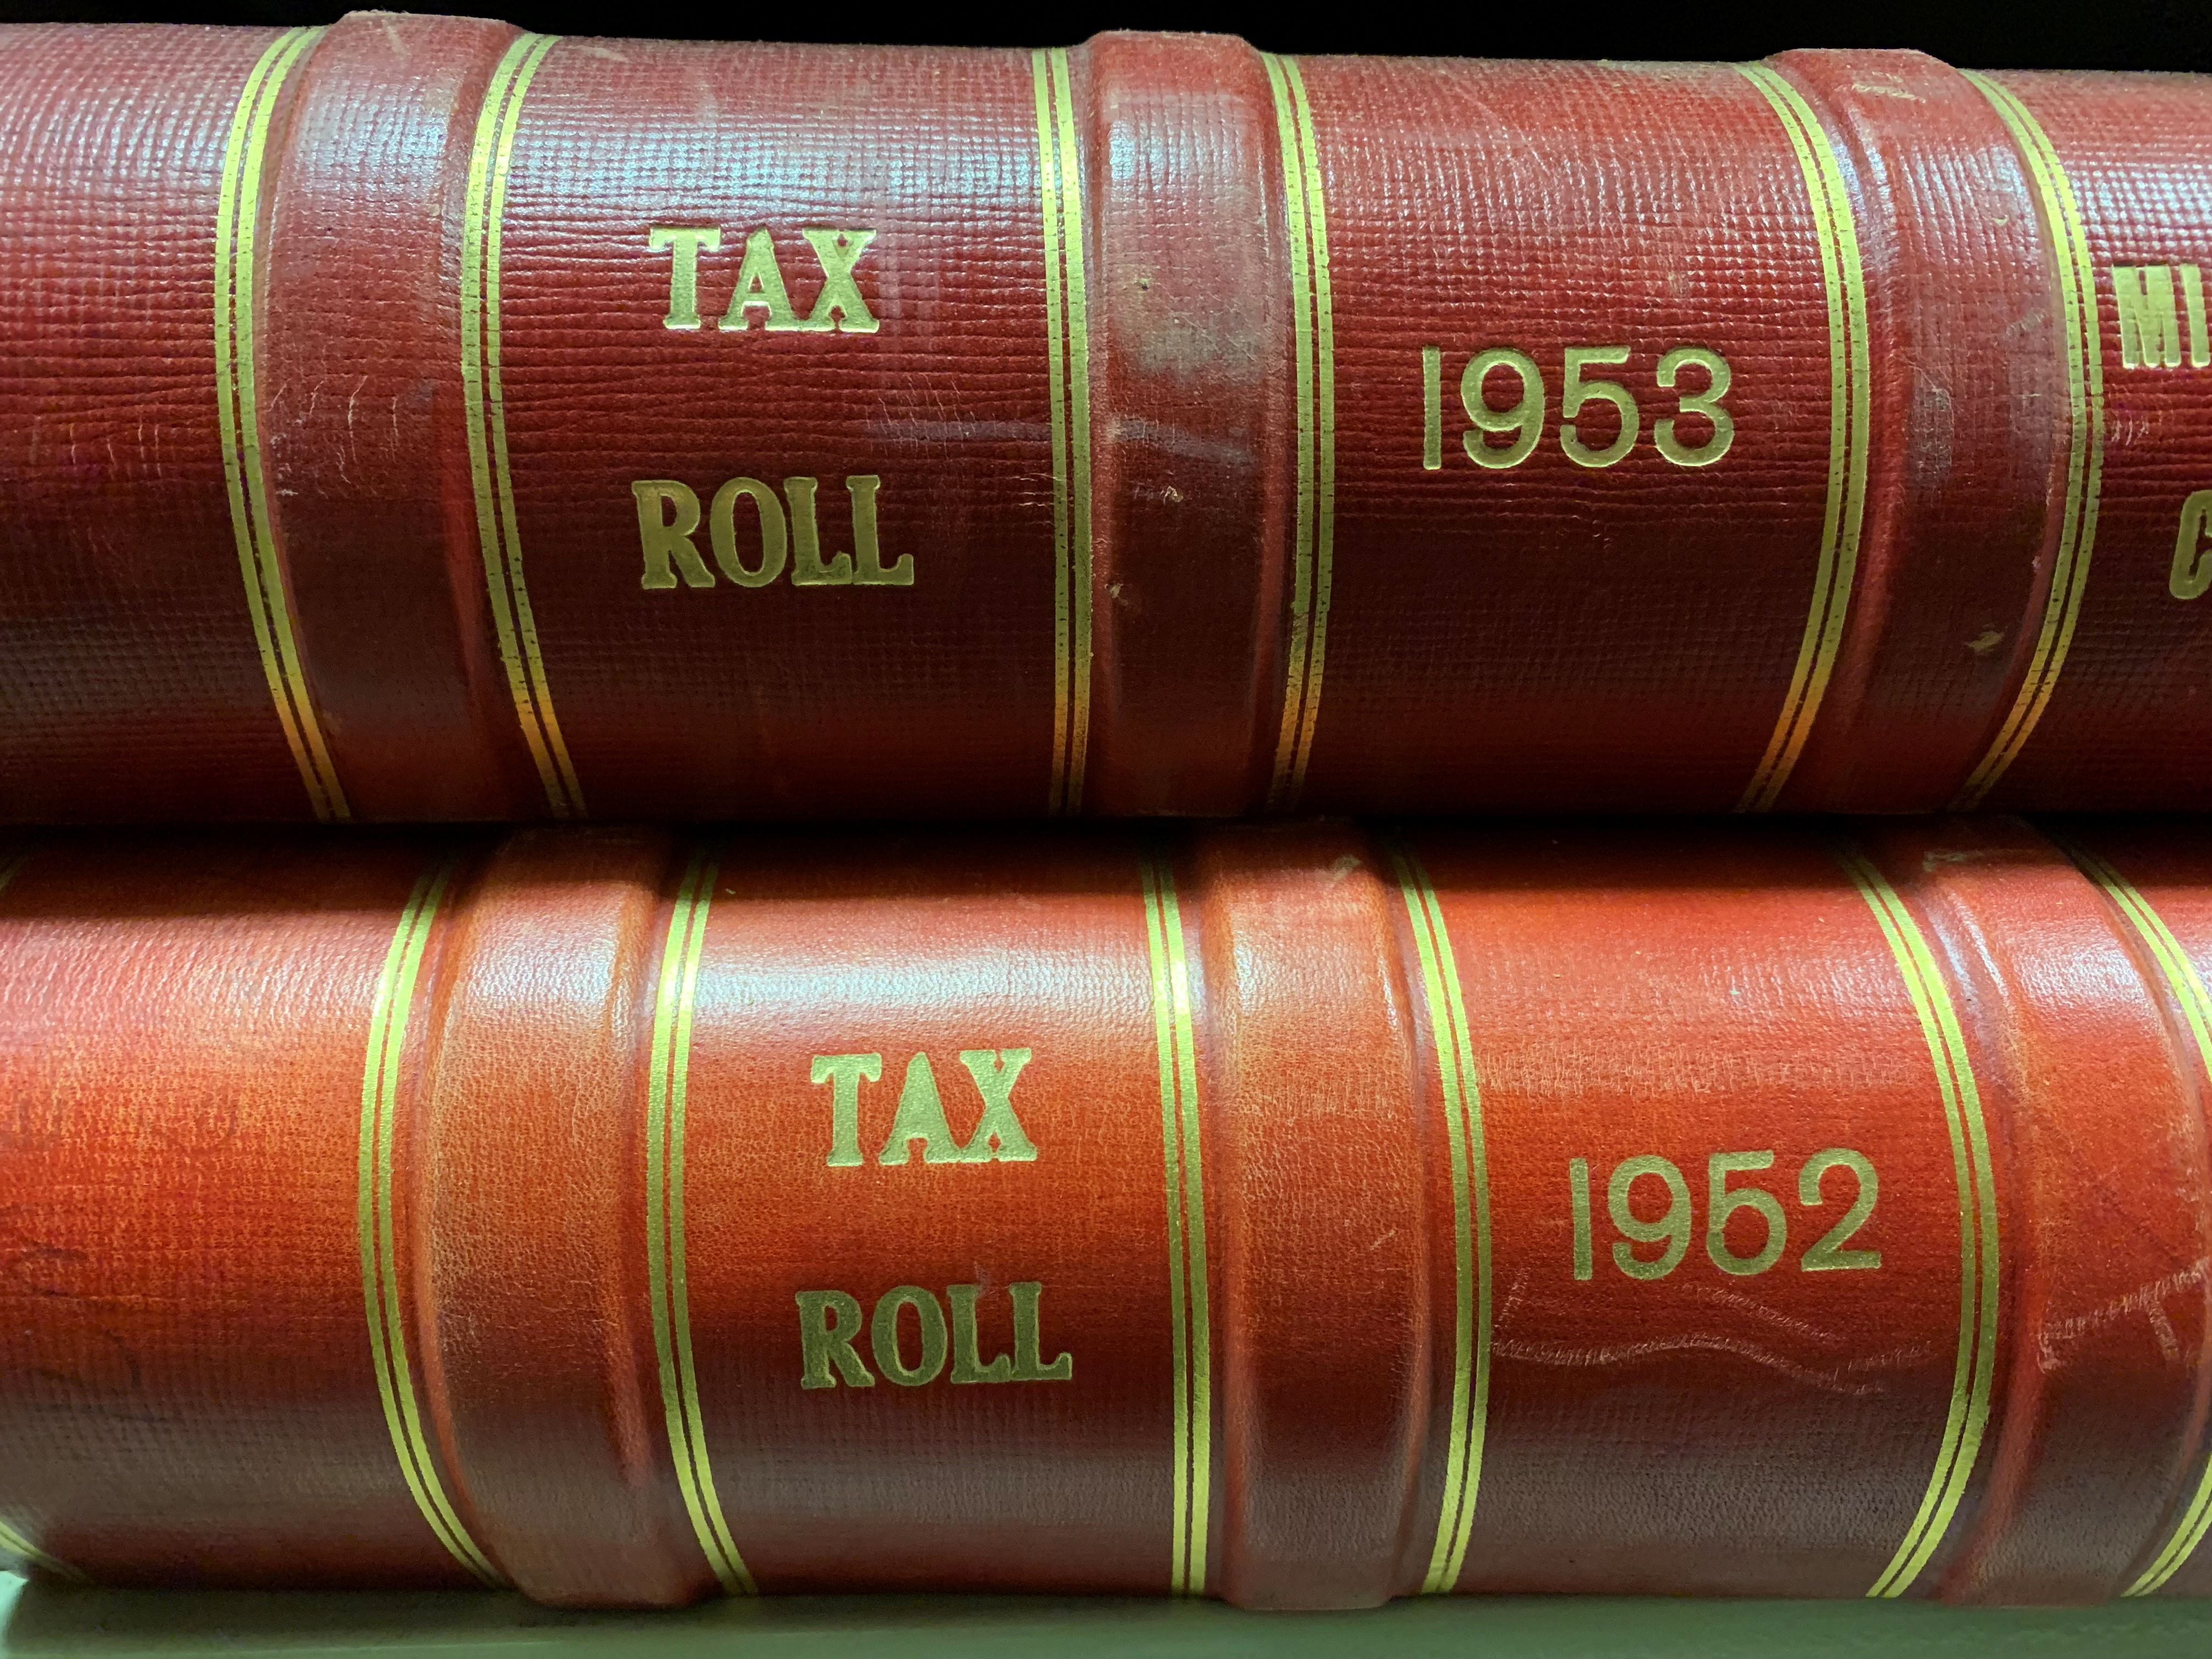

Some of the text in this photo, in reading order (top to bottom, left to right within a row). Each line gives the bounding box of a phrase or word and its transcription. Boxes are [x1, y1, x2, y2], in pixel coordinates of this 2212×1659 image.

[649, 227, 879, 333] TAX
[1422, 346, 1735, 470] 1953
[631, 475, 914, 589] ROLL
[810, 1048, 1037, 1166] TAX
[1569, 1148, 1882, 1280] 1952
[795, 1282, 1072, 1390] ROLL
